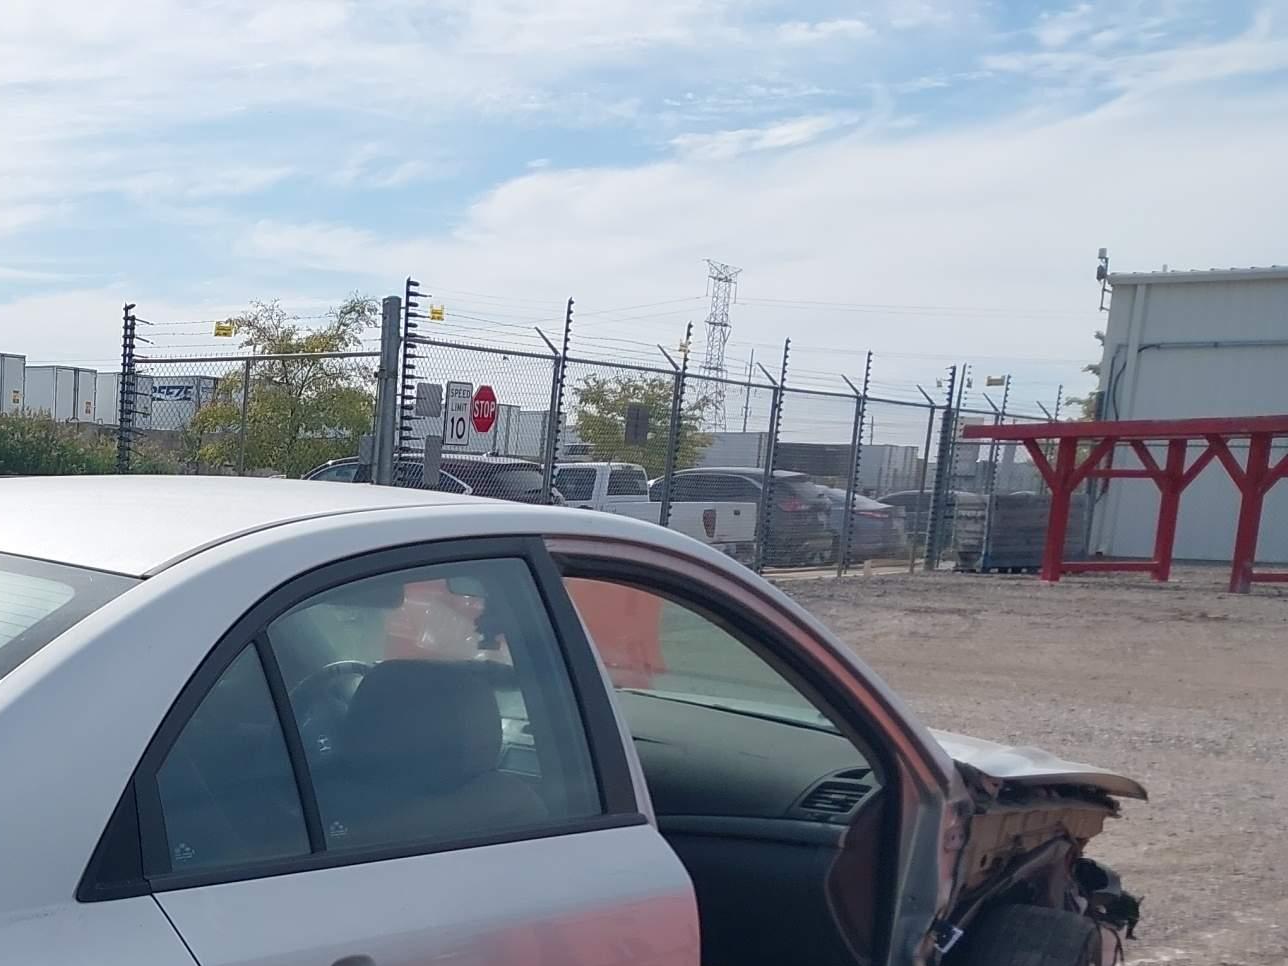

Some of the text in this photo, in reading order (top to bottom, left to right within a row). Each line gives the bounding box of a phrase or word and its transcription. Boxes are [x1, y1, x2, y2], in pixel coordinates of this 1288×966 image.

[451, 388, 471, 399] SPEED
[451, 402, 468, 412] LIMIT
[473, 400, 496, 419] STOP
[450, 416, 466, 440] 10
